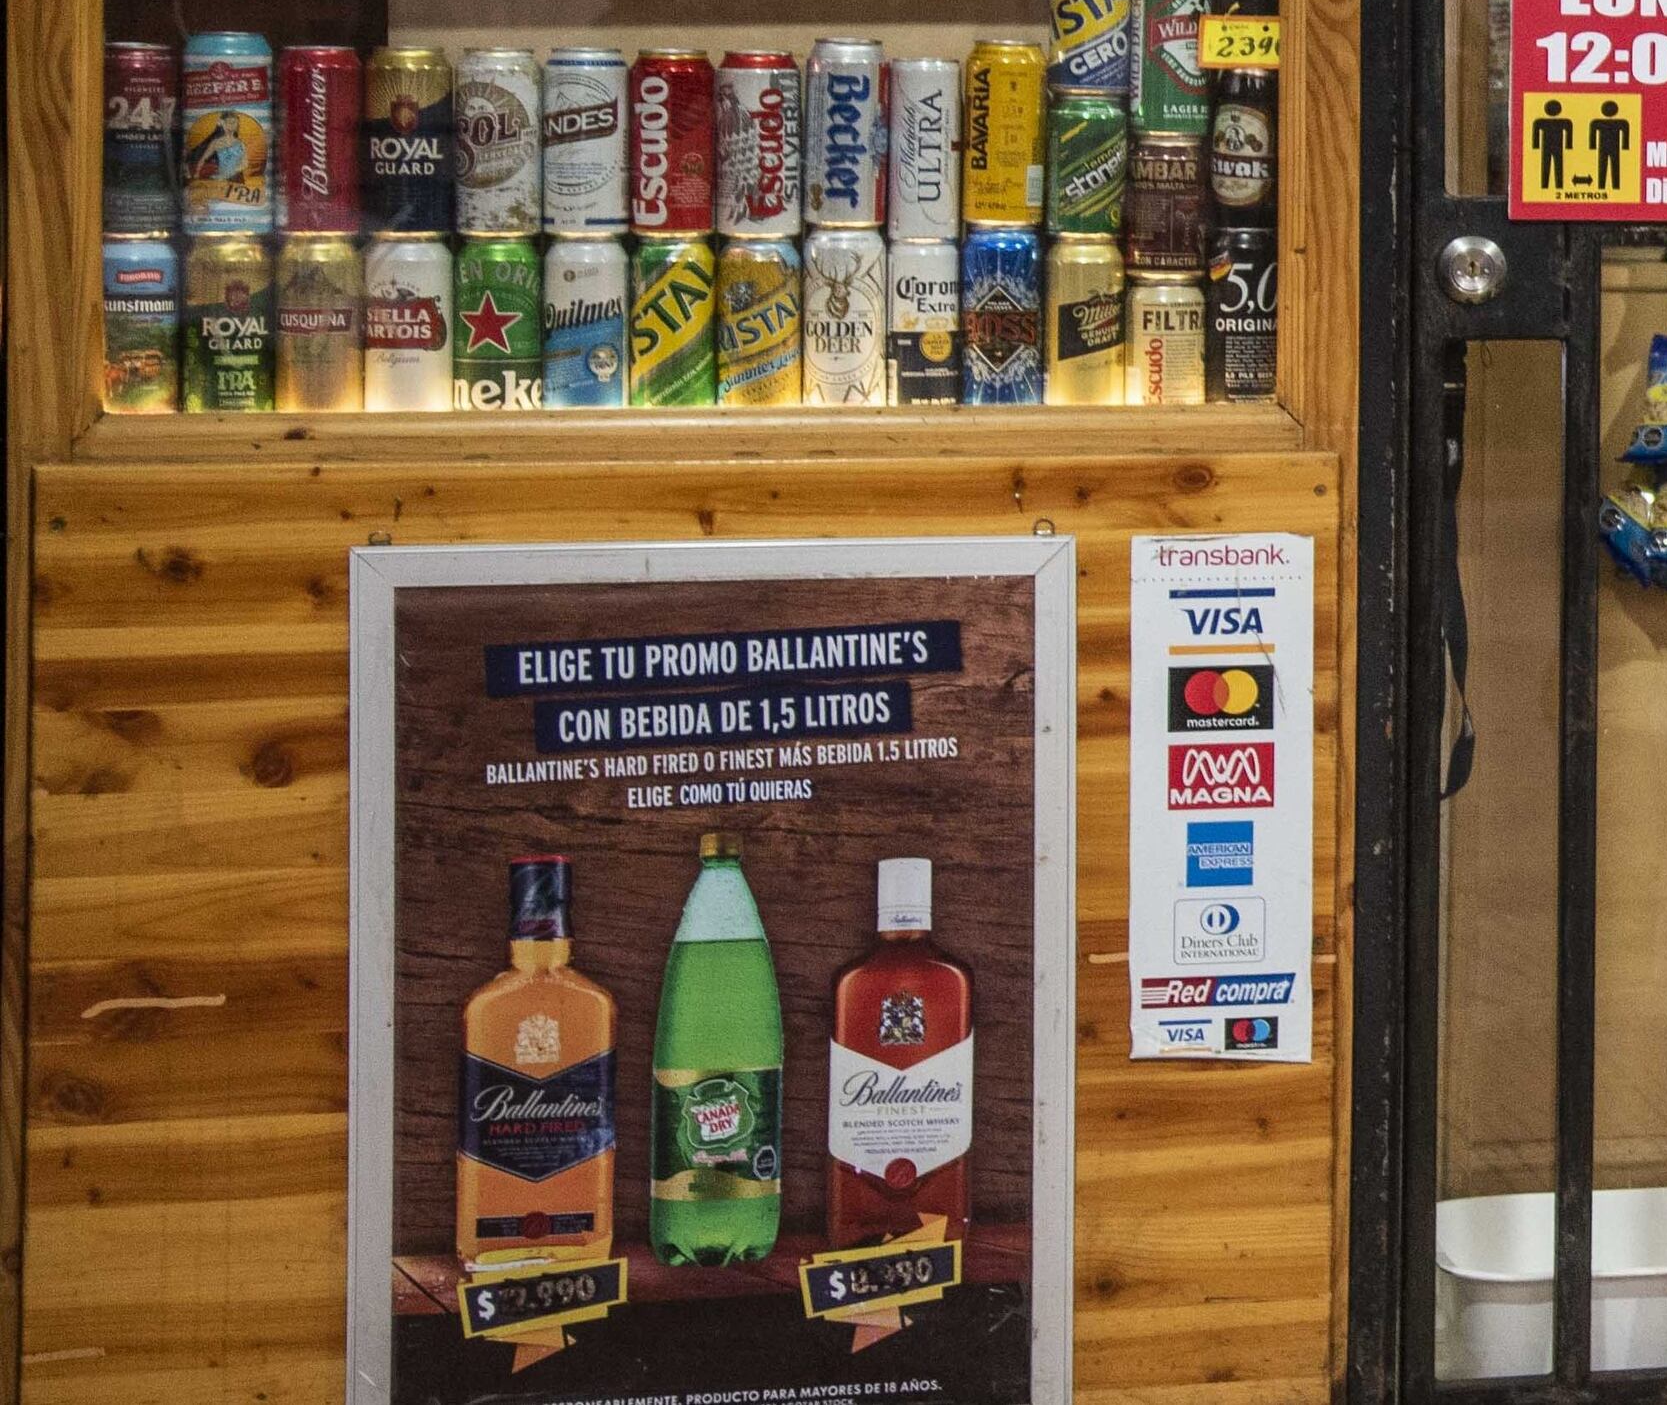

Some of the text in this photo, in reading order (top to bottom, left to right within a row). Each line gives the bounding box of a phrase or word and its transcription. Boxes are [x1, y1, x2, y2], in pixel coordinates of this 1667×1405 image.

[1158, 18, 1198, 39] WILD
[1069, 29, 1128, 77] CERO
[970, 67, 992, 171] BAVARIA
[301, 66, 328, 197] Budweiser
[823, 71, 871, 209] Becker
[370, 136, 443, 161] ROYAL
[632, 75, 670, 227] Escudo
[744, 88, 784, 219] Escudo
[918, 89, 943, 203] ULTRA
[375, 161, 435, 176] GUARD
[1554, 191, 1609, 200] 2 METROS
[366, 306, 431, 324] STELLA
[917, 297, 956, 314] Extra
[202, 315, 270, 338] ROYAL
[367, 323, 432, 341] ARTOIS
[805, 320, 874, 338] GOLDEN
[1080, 322, 1121, 343] GENUINE
[814, 337, 863, 354] DEER
[1087, 331, 1119, 348] DRAFT
[217, 370, 257, 391] IPA
[1180, 607, 1265, 636] VISA
[517, 629, 929, 686] ELIGE TU PROMO BALLANTINE'S
[558, 690, 891, 744] CON BEBIDA DE 1,5 LITROS
[486, 736, 959, 785] BALLANTINE'S HARD FIRED O FINEST MÁS BEBIDA 1.5 LITROS
[627, 776, 813, 810] ELIGE COMO TÚ QUIERAS
[1170, 786, 1273, 807] MAGNA
[1187, 843, 1250, 857] AMERICAN
[1200, 856, 1254, 869] EXPRESS
[1180, 934, 1258, 949] Diners Club
[1179, 948, 1260, 959] INTERNATIONAL
[1166, 978, 1211, 1006] Red
[1166, 1028, 1205, 1043] VISA
[695, 1103, 741, 1124] CANADA
[876, 1106, 926, 1116] FINEST
[708, 1117, 734, 1134] DRY
[842, 1116, 961, 1129] BLENDED SCOTCH WHISKY
[686, 1389, 759, 1405] PRODUCTO
[763, 1387, 796, 1400] PARA
[800, 1383, 862, 1399] MAYORES
[864, 1382, 881, 1395] DE
[884, 1381, 898, 1394] 18
